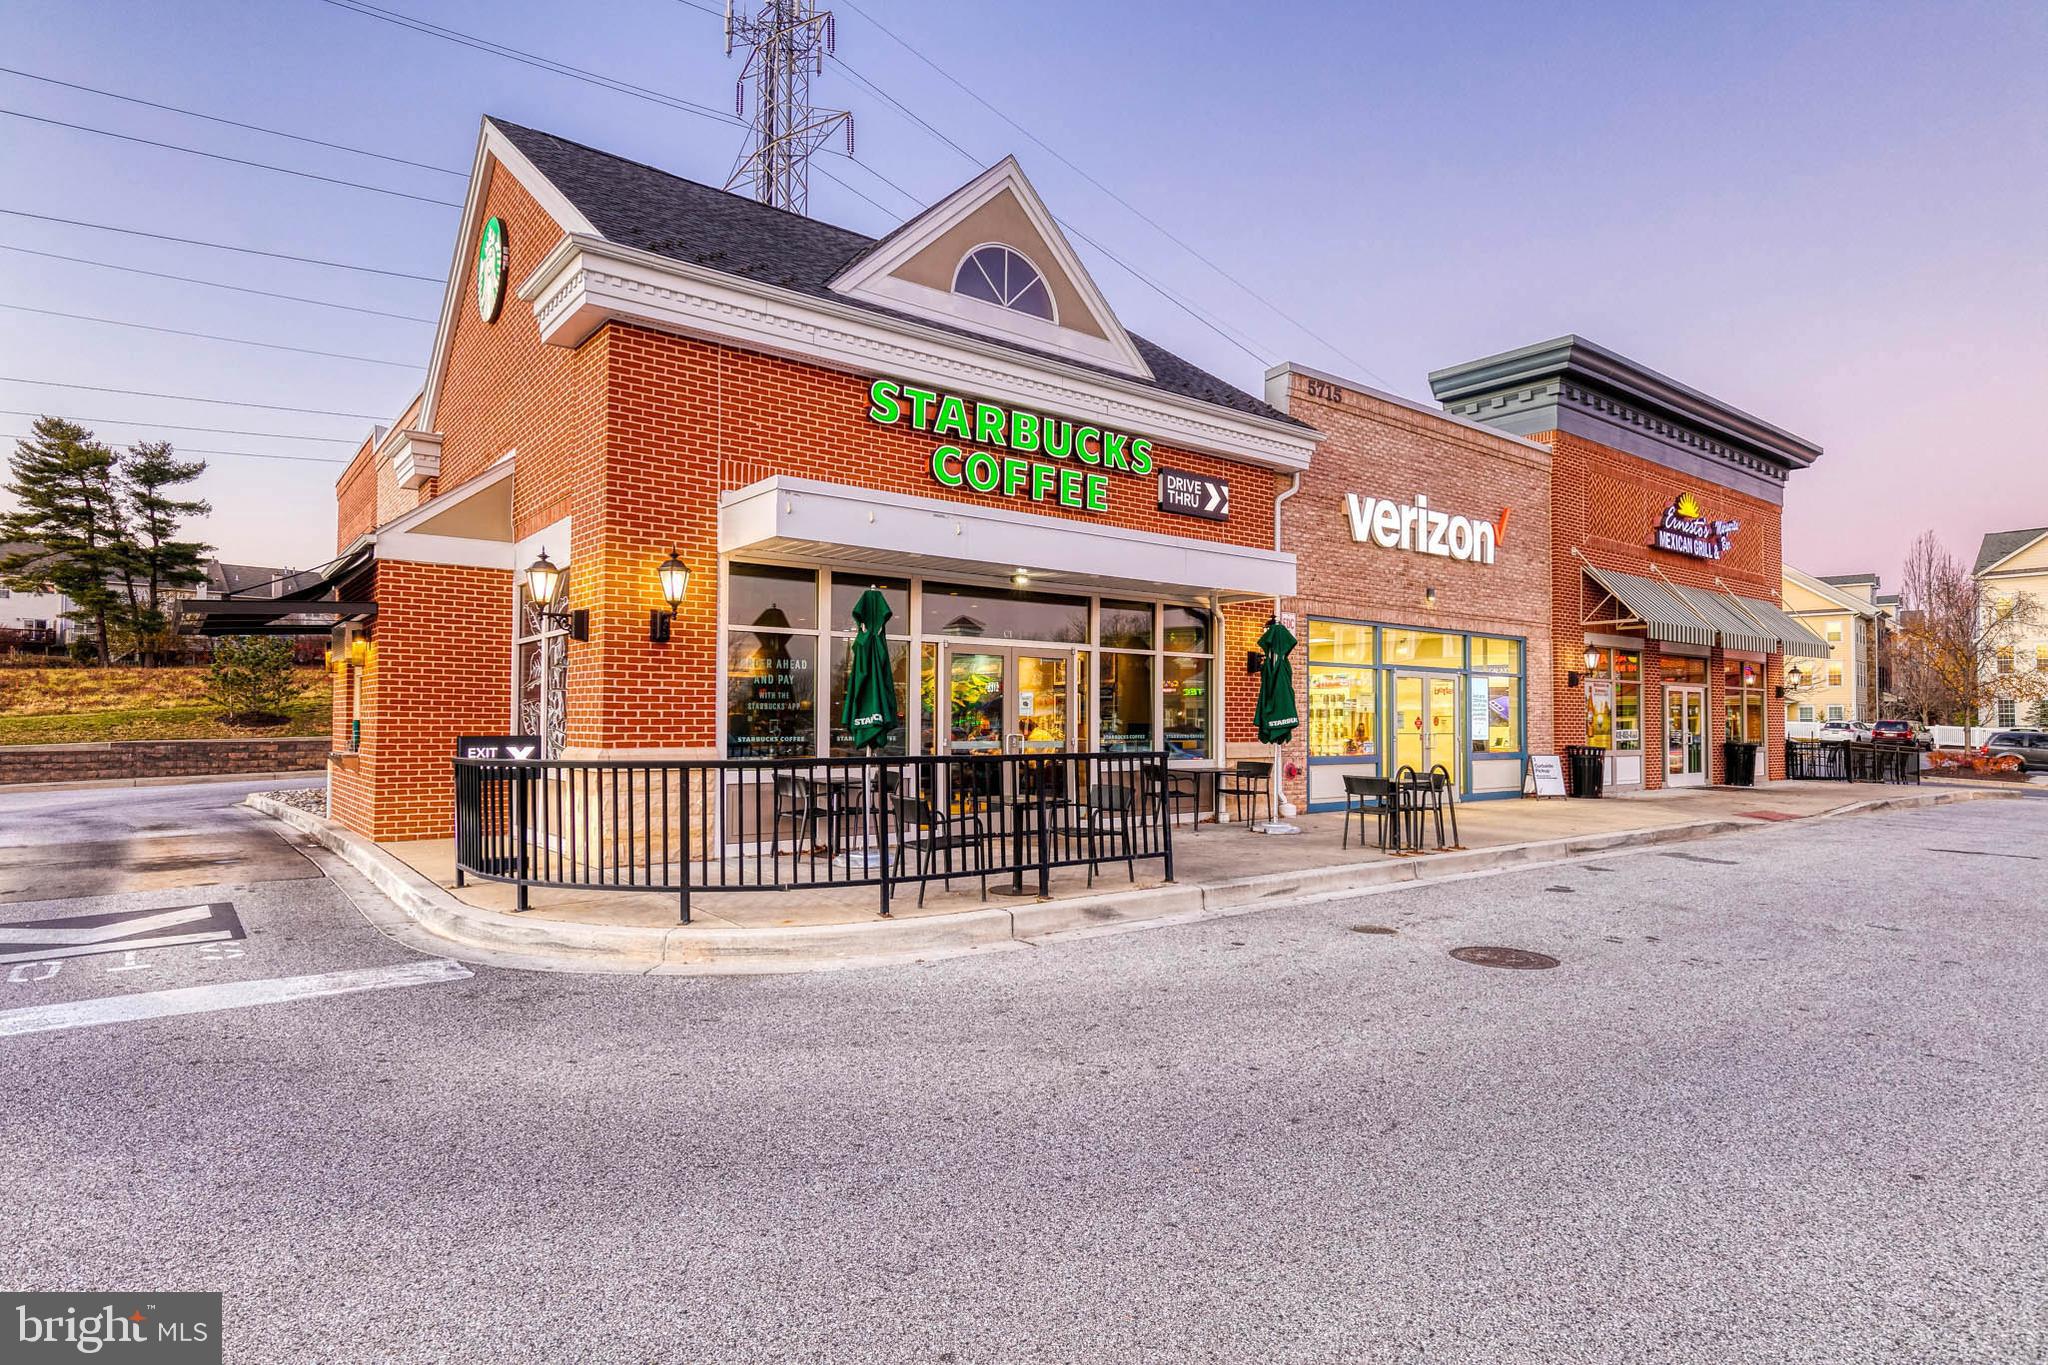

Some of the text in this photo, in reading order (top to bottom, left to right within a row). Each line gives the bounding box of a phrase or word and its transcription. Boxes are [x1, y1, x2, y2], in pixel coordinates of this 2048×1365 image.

[1308, 379, 1342, 403] 5715
[869, 380, 1153, 475] STARBUCKS
[932, 445, 1109, 512] COFFEE
[1167, 475, 1202, 495] DRIVE
[1168, 489, 1199, 508] THRU
[1345, 493, 1495, 564] verizon
[1659, 530, 1693, 554] MEXICAN
[1693, 540, 1713, 559] GRILL
[776, 659, 808, 669] AHEAD
[753, 674, 794, 685] AND PAY
[747, 702, 785, 710] STARBUCKS
[467, 747, 498, 759] EXIT
